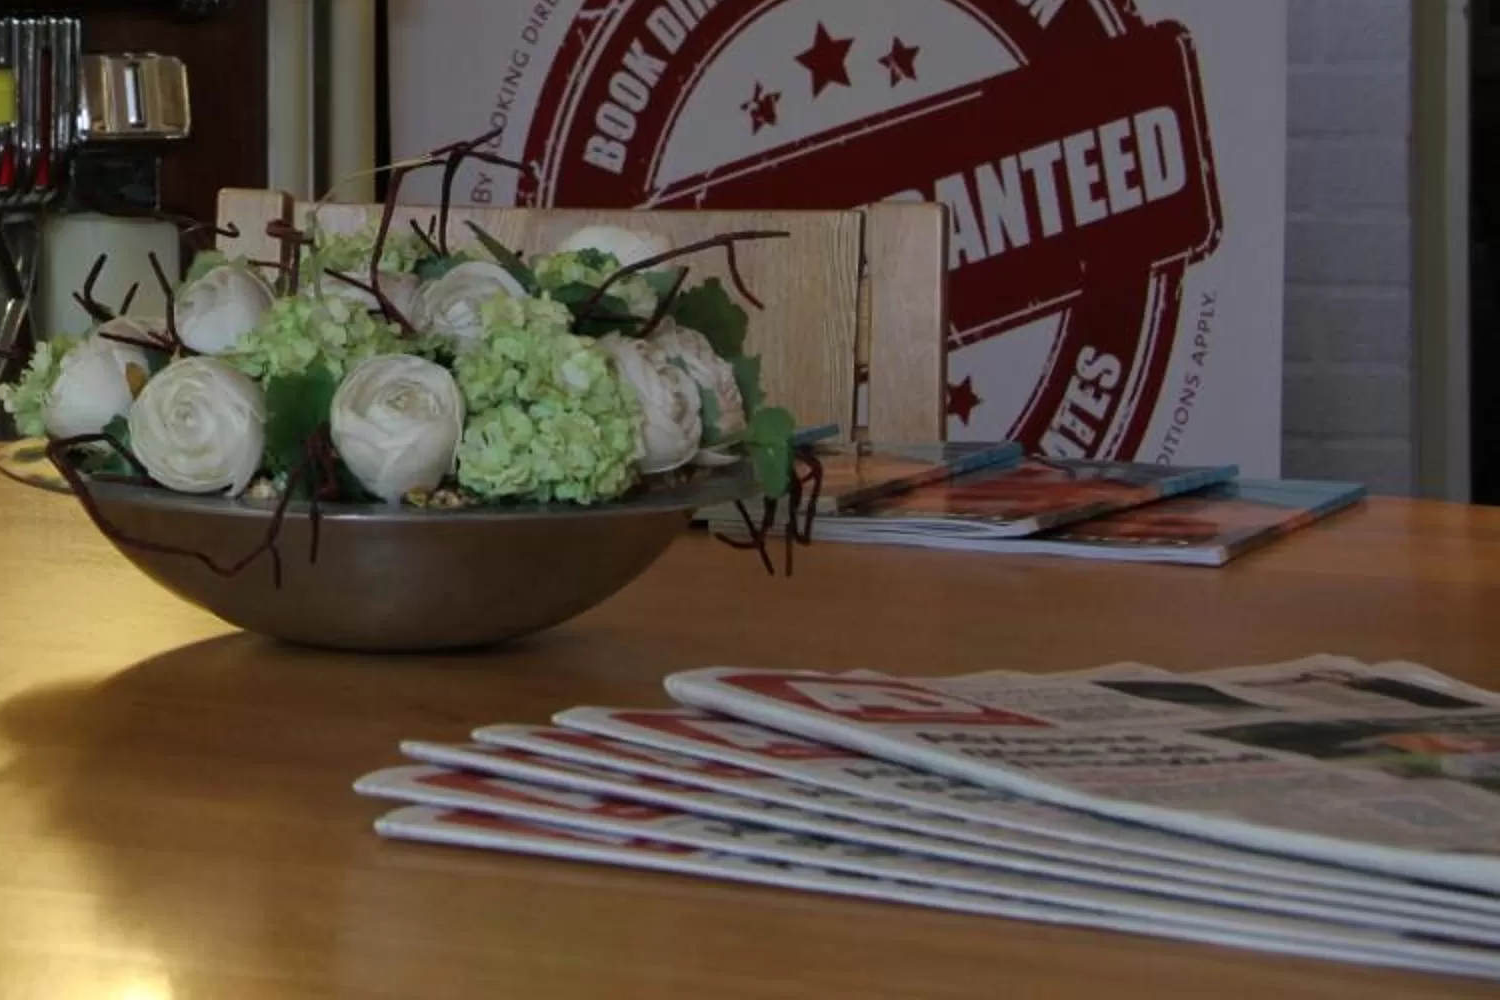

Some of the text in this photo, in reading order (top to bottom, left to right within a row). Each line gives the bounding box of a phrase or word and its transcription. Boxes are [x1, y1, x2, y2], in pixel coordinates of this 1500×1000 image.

[486, 49, 531, 162] OOKING
[582, 36, 669, 175] BOOK
[880, 106, 1187, 271] ANTEED
[1039, 345, 1121, 460] ATES
[1156, 372, 1201, 464] DITIONS
